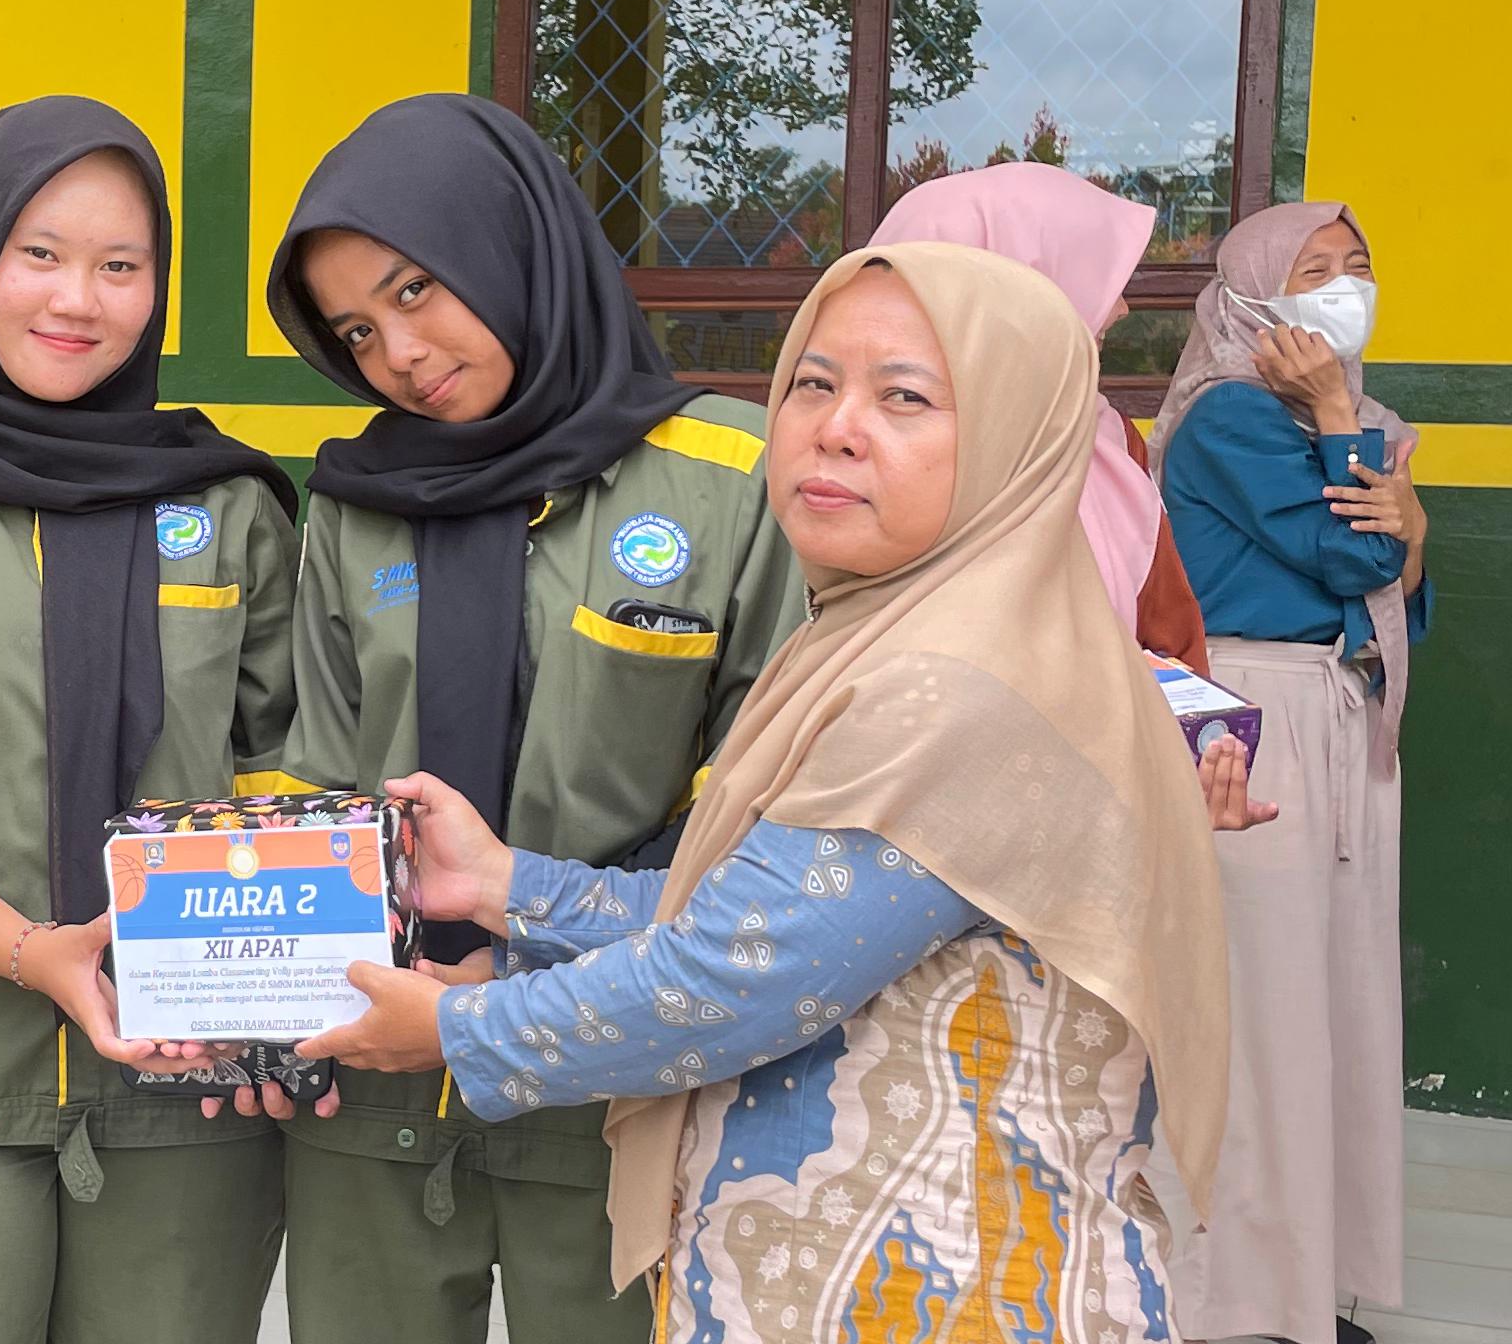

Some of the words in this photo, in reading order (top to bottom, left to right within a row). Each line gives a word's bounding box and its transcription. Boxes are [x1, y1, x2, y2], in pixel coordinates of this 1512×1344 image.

[370, 561, 417, 589] SMK
[180, 885, 286, 918] JUARA
[296, 884, 318, 914] 2
[204, 940, 234, 959] XII
[238, 938, 299, 958] APAT
[293, 967, 314, 976] yang
[140, 982, 158, 993] pada
[174, 982, 188, 990] dan
[196, 981, 235, 990] Desember
[259, 980, 267, 989] di
[268, 980, 293, 989] SMKN
[191, 1020, 212, 1031] OSIS
[214, 1020, 242, 1031] SMKN
[293, 1019, 324, 1029] TIMUR
